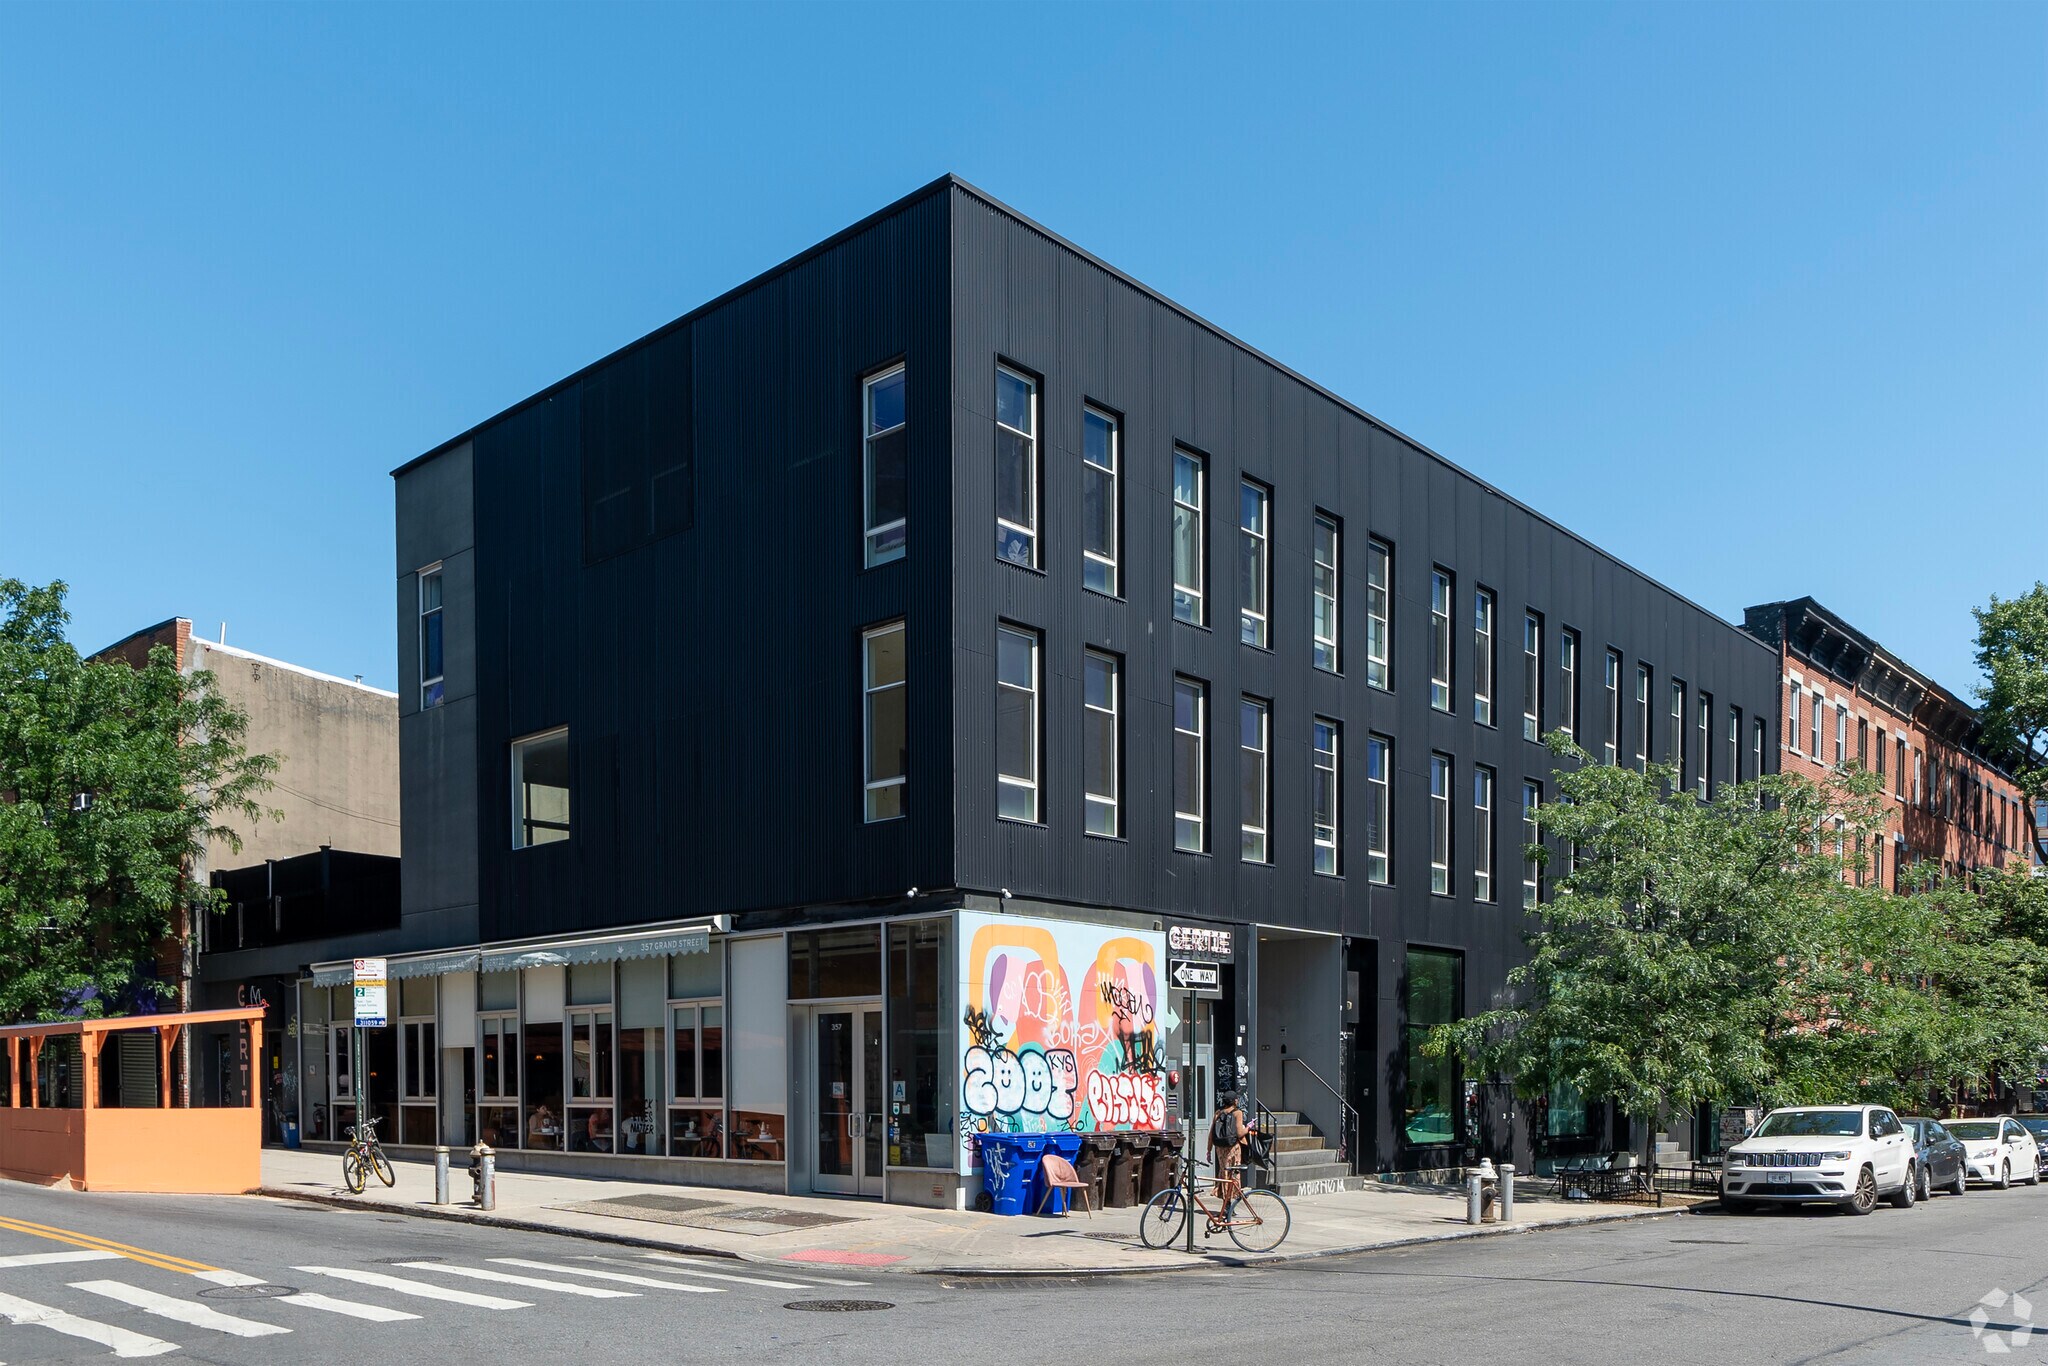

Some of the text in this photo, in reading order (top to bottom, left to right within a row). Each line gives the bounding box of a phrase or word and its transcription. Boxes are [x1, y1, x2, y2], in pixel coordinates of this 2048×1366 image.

[641, 937, 704, 952] 357 GRAND STREET
[1169, 926, 1231, 954] GERTIE
[1180, 969, 1214, 981] ONE WAY
[357, 988, 363, 996] 2
[831, 1023, 842, 1031] 357
[1049, 1054, 1073, 1072] KYS
[896, 1083, 904, 1096] A
